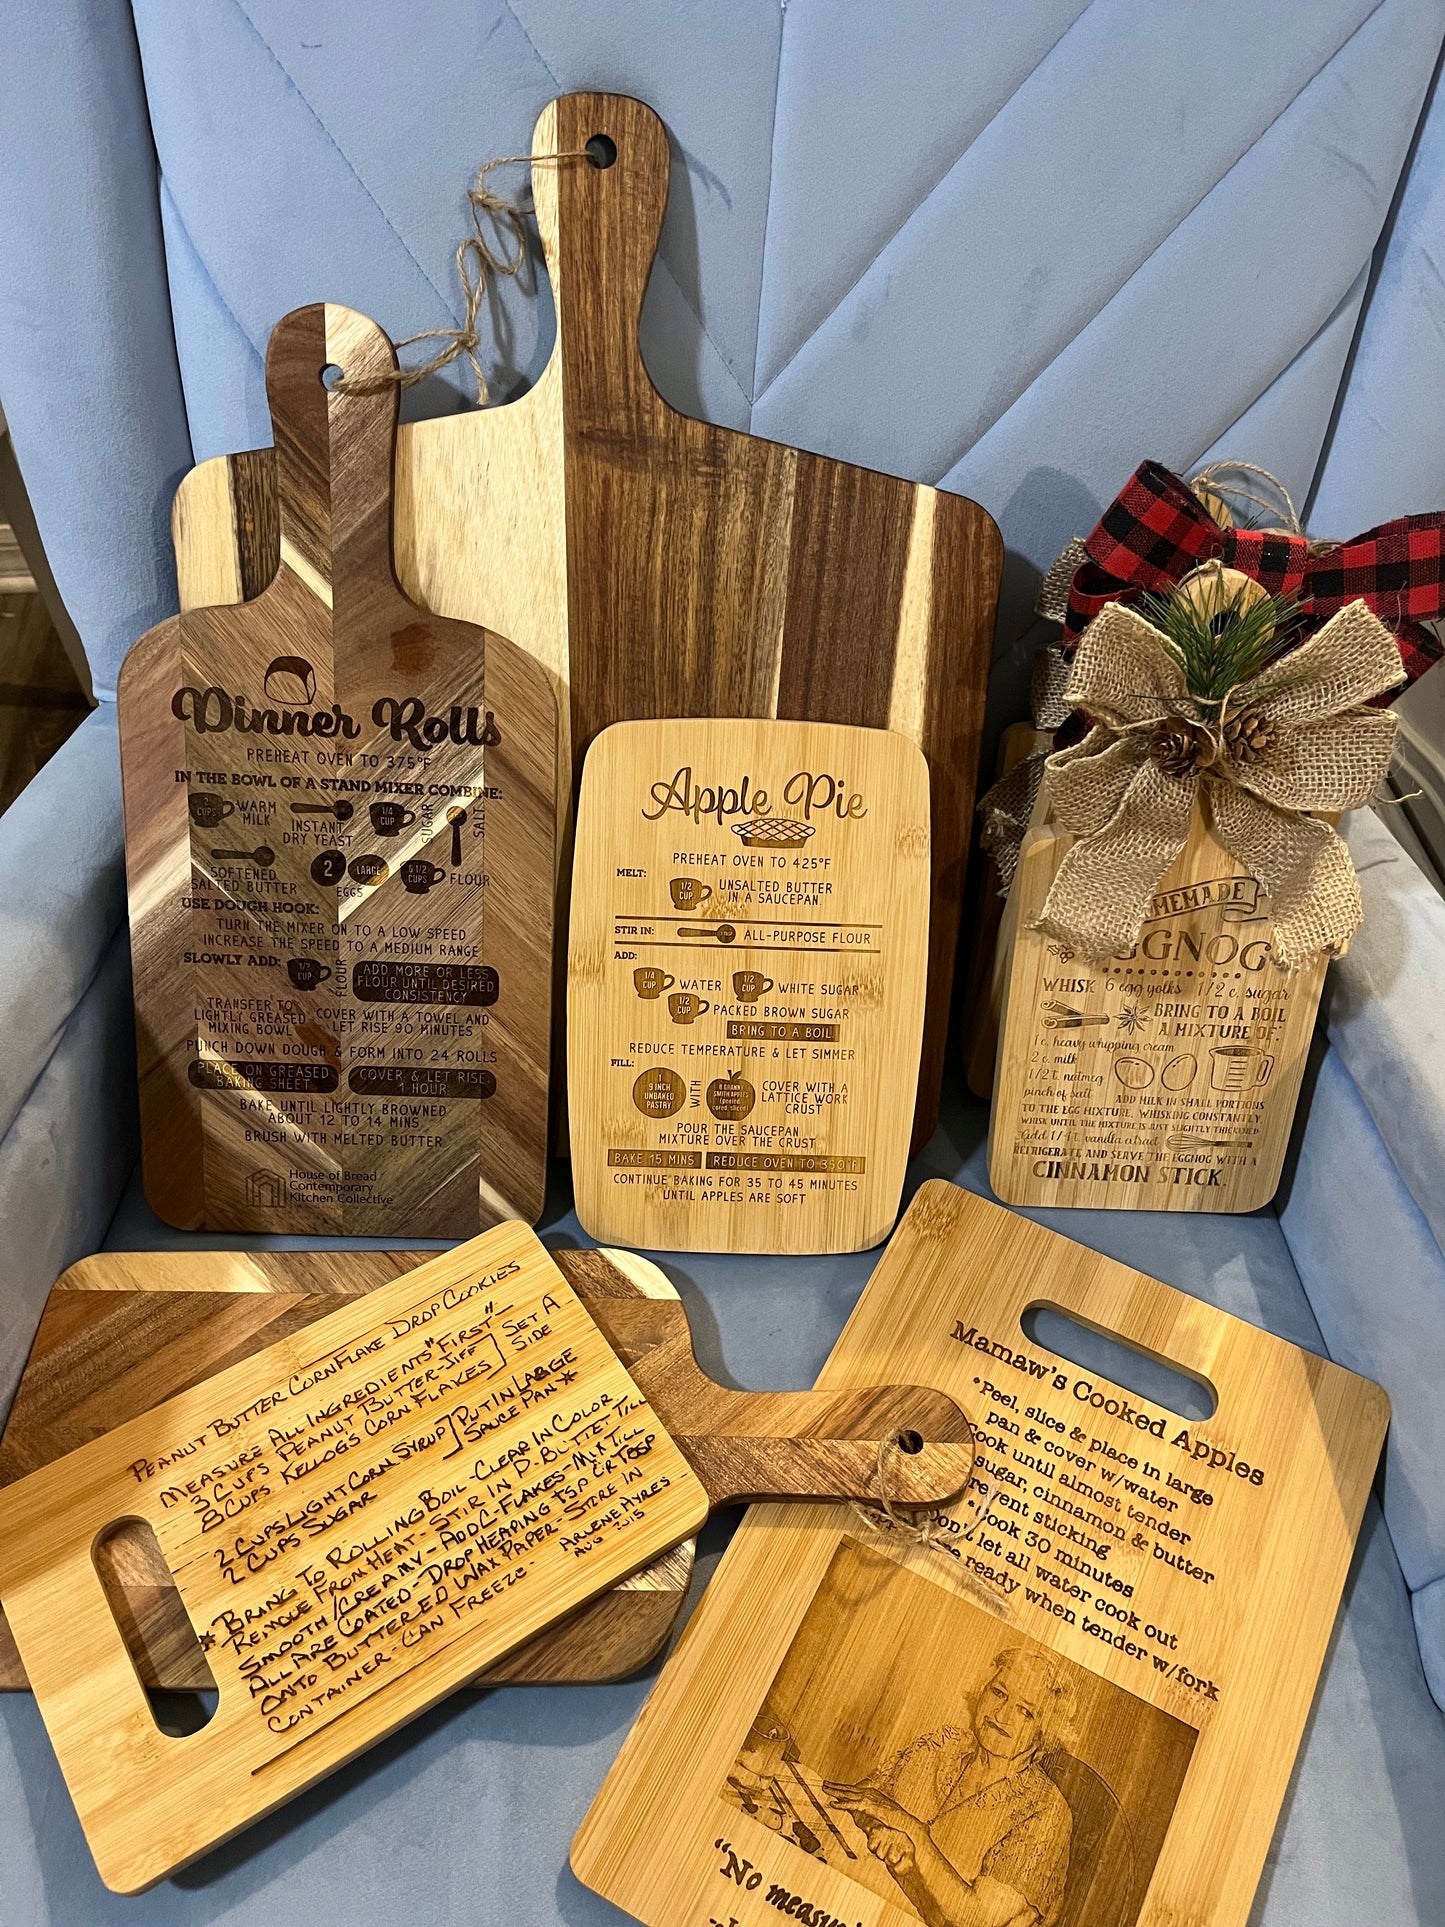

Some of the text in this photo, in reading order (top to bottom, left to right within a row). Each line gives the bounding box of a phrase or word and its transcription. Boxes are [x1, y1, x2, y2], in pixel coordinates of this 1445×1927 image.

[171, 687, 502, 751] Dinner Rolls
[247, 748, 431, 770] PREHEAT OVEN TO 375°F
[175, 771, 503, 800] IN THE BOWL OF A STAND MIXER COMBINE:
[641, 766, 868, 825] Apple Pie
[236, 800, 276, 814] WARM
[382, 807, 393, 816] 1/4
[243, 814, 271, 825] MILK
[292, 820, 344, 833] INSTANT
[380, 816, 395, 826] CUP
[422, 803, 434, 843] SUGAR
[473, 808, 485, 838] SALT
[283, 833, 353, 847] DRY YEAST
[672, 852, 831, 870] PREHEAT OVEN TO 425°F
[210, 867, 276, 880] SOFTENED
[323, 861, 333, 877] 2
[356, 866, 381, 875] LARGE
[616, 868, 646, 878] MELT:
[191, 879, 297, 894] SALTED BUTTER
[450, 874, 490, 886] FLOUR
[680, 882, 692, 890] 1/2
[719, 879, 833, 895] UNSALTED BUTTER
[337, 887, 363, 898] EGGS
[679, 891, 693, 900] CUP
[728, 892, 738, 902] IN
[745, 893, 752, 903] A
[1152, 881, 1245, 917] MEMADE
[182, 898, 319, 914] USE DOUGH HOOK:
[615, 926, 654, 935] STIR IN:
[744, 929, 825, 943] ALL-PURPOSE
[832, 932, 871, 944] FLOUR
[614, 951, 637, 960] ADD:
[1113, 929, 1272, 971] GNOG
[183, 953, 281, 966] SLOWLY ADD:
[679, 979, 722, 991] WATER
[779, 983, 859, 996] WHITE SUGAR
[1043, 978, 1182, 998] WHISK 6 egg yolks
[1198, 982, 1290, 1000] 1/2 c. sugar
[713, 1005, 849, 1020] PACKED BROWN SUGAR
[1154, 1003, 1286, 1022] BRING TO A BOIL
[731, 1025, 832, 1039] BRING TO A BOIL
[1159, 1023, 1167, 1036] A
[1175, 1023, 1250, 1039] MIXTURE
[611, 1059, 634, 1067] FILL:
[762, 1081, 848, 1093] COVER WITH A
[761, 1092, 848, 1104] LATTICE WORK
[785, 1104, 822, 1115] CRUST
[244, 1130, 442, 1148] BRUSH WITH MELTED BUTTER
[615, 1153, 694, 1165] BAKE 15 MINS
[290, 1169, 377, 1181] House of Bread
[1033, 1161, 1228, 1187] CINNAMON STICK.
[290, 1181, 373, 1193] Contemporary
[290, 1193, 393, 1205] Kitchen Collective
[663, 1189, 806, 1205] UNTIL APPLES ARE SOFT
[127, 1435, 208, 1482] PEANUT
[207, 1392, 287, 1437] BUTTER
[385, 1304, 440, 1338] DROP
[443, 1261, 520, 1310] COOKIES
[365, 1405, 411, 1436] CORN
[410, 1360, 491, 1408] FLAKES
[950, 1320, 1265, 1486] Mamaw's Cooked Apples
[160, 1446, 263, 1508] MEASURE
[268, 1423, 305, 1446] ALL
[305, 1350, 432, 1426] INGREDIENTS
[985, 1411, 1179, 1513] pan & cover w/water
[1024, 1406, 1214, 1507] slice & place in large
[302, 1491, 377, 1537] SUGAR
[429, 1496, 486, 1532] STIR
[974, 1454, 1215, 1585] sugar, cinnamon & butter
[977, 1532, 1178, 1650] let all water cook out
[965, 1554, 1220, 1701] ready when tender w/fork
[250, 1635, 338, 1698] ALL ARE
